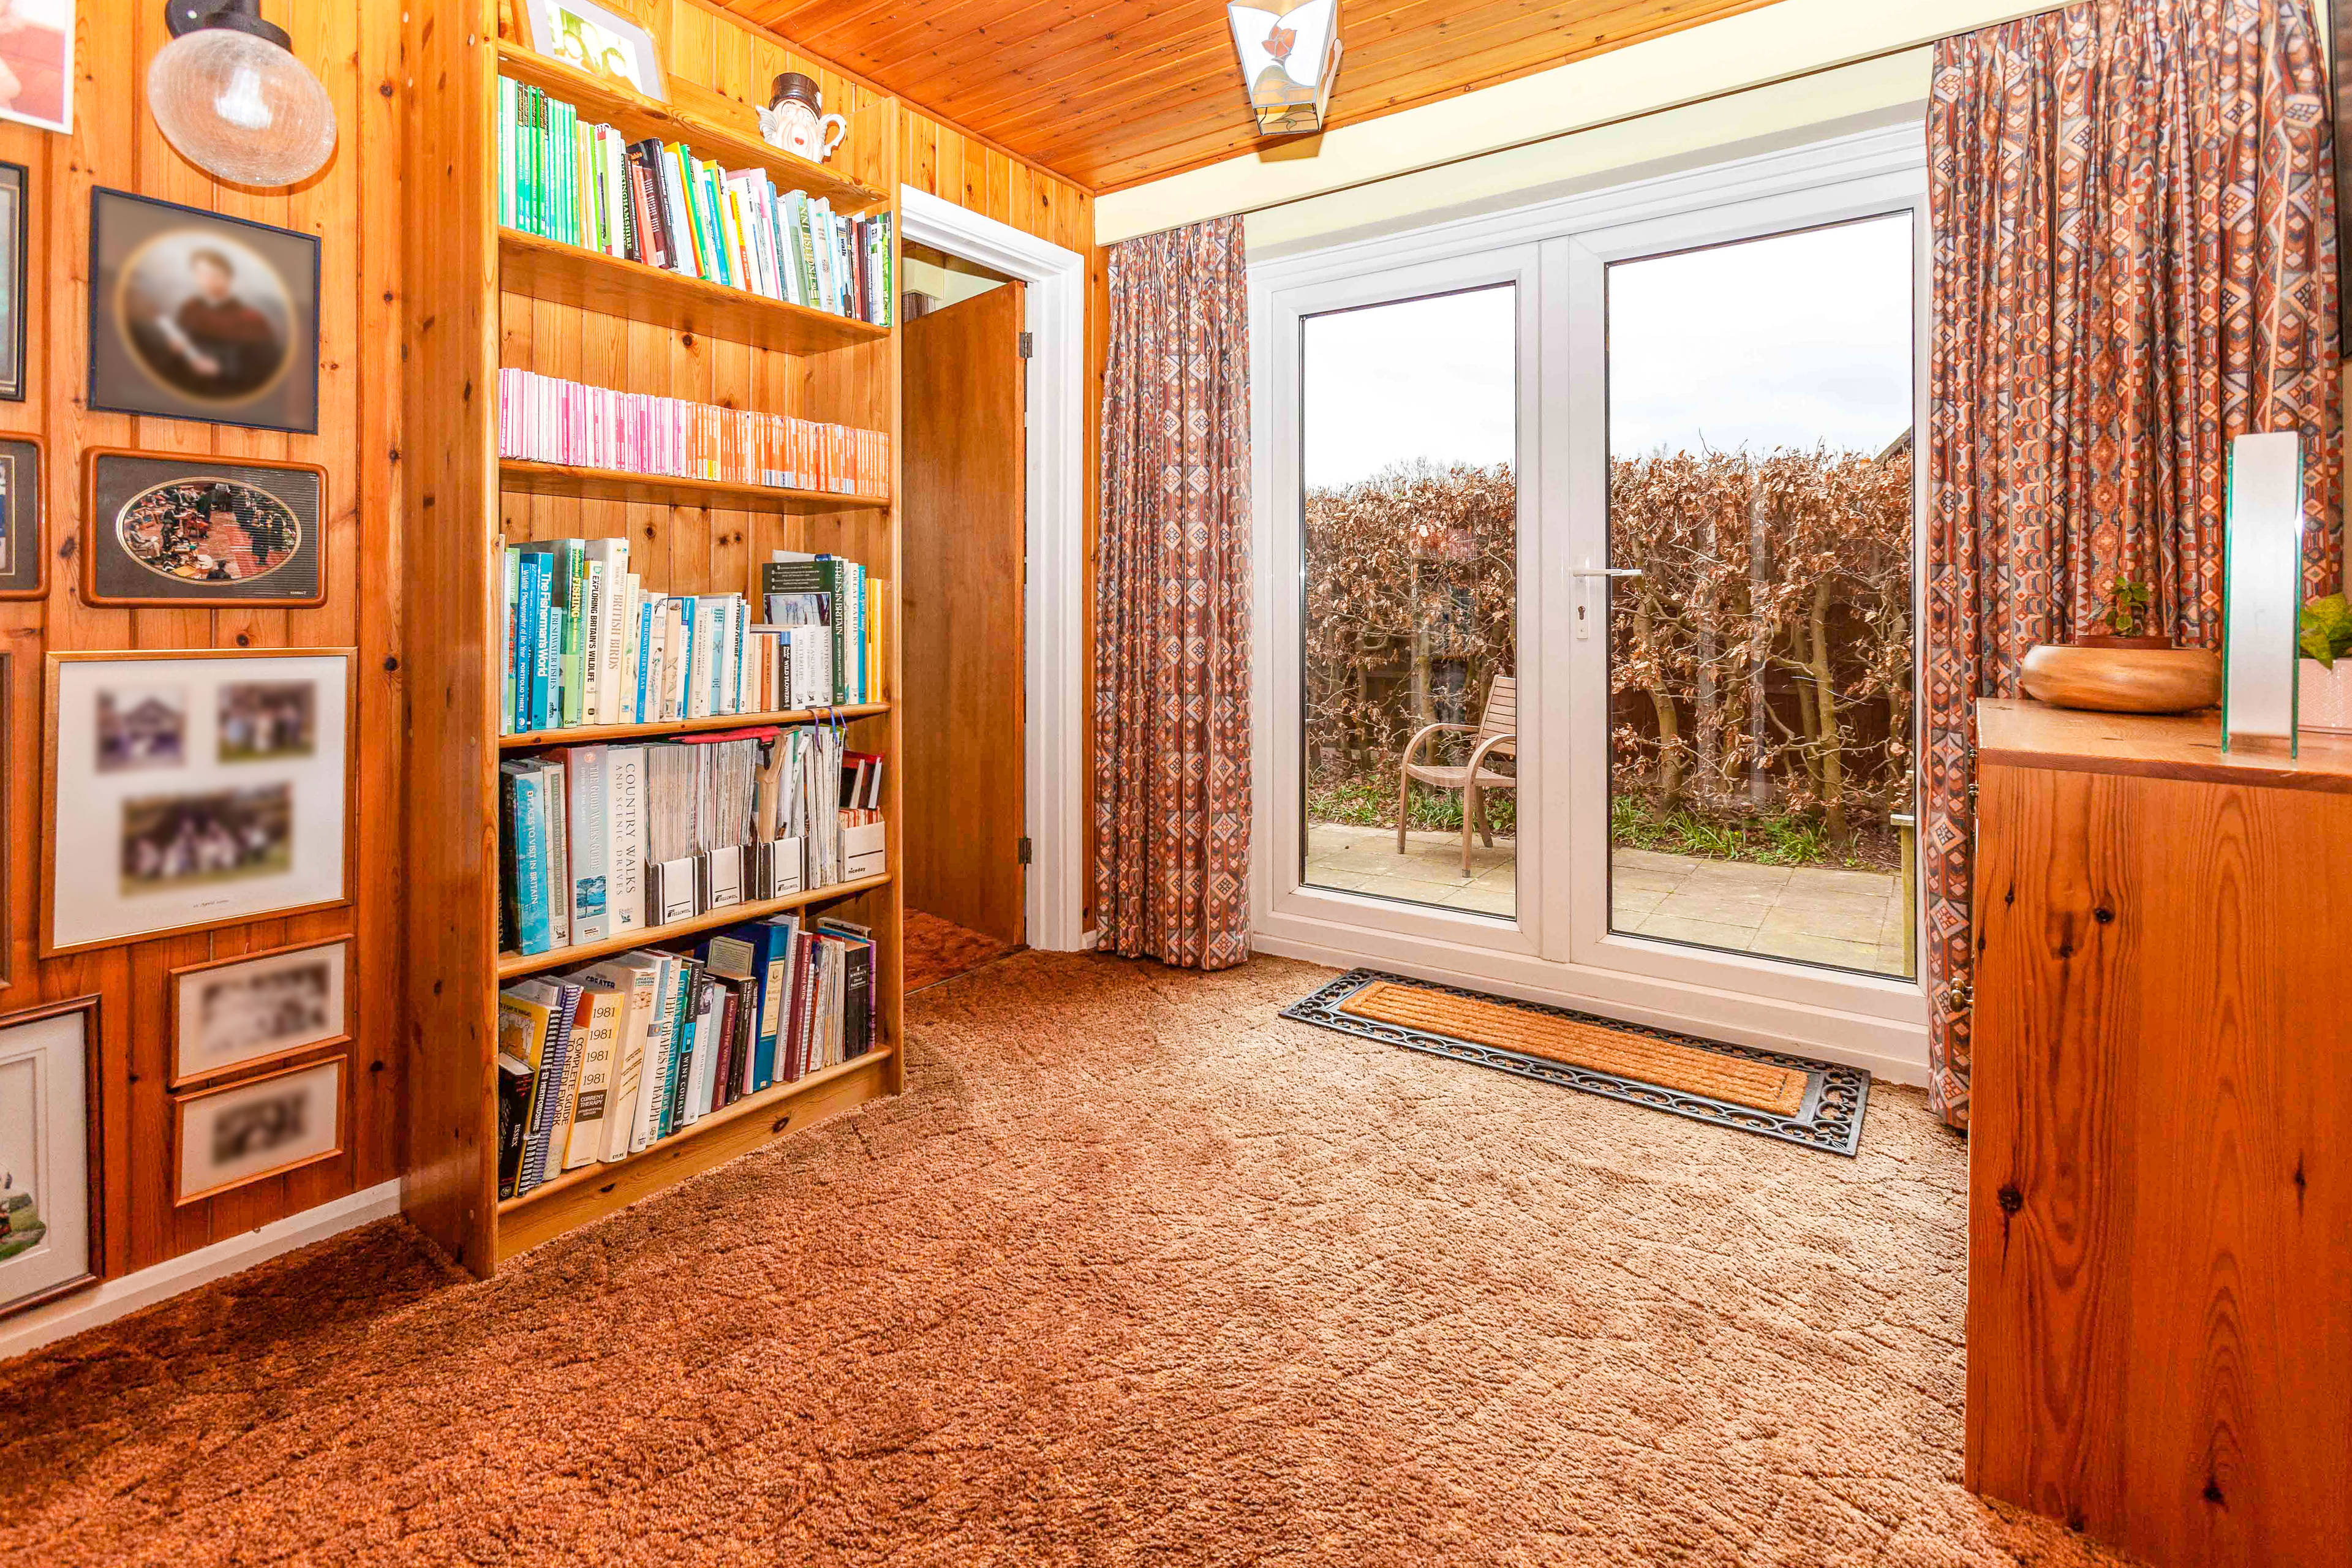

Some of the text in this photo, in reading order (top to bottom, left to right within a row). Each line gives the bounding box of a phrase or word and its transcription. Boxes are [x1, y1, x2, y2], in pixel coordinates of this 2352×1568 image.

[801, 207, 816, 280] ENGLISH INN
[520, 591, 529, 628] Photographer
[571, 577, 581, 619] FISHING
[835, 593, 843, 602] IN
[538, 572, 551, 677] The Fisherman's World
[587, 576, 599, 682] EXPLORING BRITAIN'S WILDLIFE
[608, 595, 624, 669] BRITISH BIRDS
[835, 603, 844, 635] BRITAIN
[641, 624, 650, 671] BIRDWATCHER'S
[529, 826, 535, 837] TO
[590, 765, 601, 870] THE GOOD WALKS GUIDE
[625, 763, 636, 894] COUNTRY WALKS
[530, 860, 537, 869] IN
[586, 975, 615, 989] GREATER
[593, 1007, 615, 1018] 1981
[664, 993, 677, 1018] THE
[590, 1029, 612, 1040] 1981
[658, 1021, 673, 1065] GRAPES
[586, 1051, 608, 1062] 1981
[655, 1067, 666, 1082] OF
[551, 1038, 576, 1126] TO NEEDLEWORK
[561, 1037, 584, 1125] COMPLETE GUIDE
[583, 1073, 605, 1085] 1981
[665, 1068, 674, 1090] WINE
[677, 1056, 690, 1115] WINE COURSE
[533, 1080, 547, 1131] HERTFORDSHIRE
[649, 1085, 664, 1122] RALPH
[662, 1091, 671, 1112] BOOK
[511, 1123, 521, 1148] ESSEX
